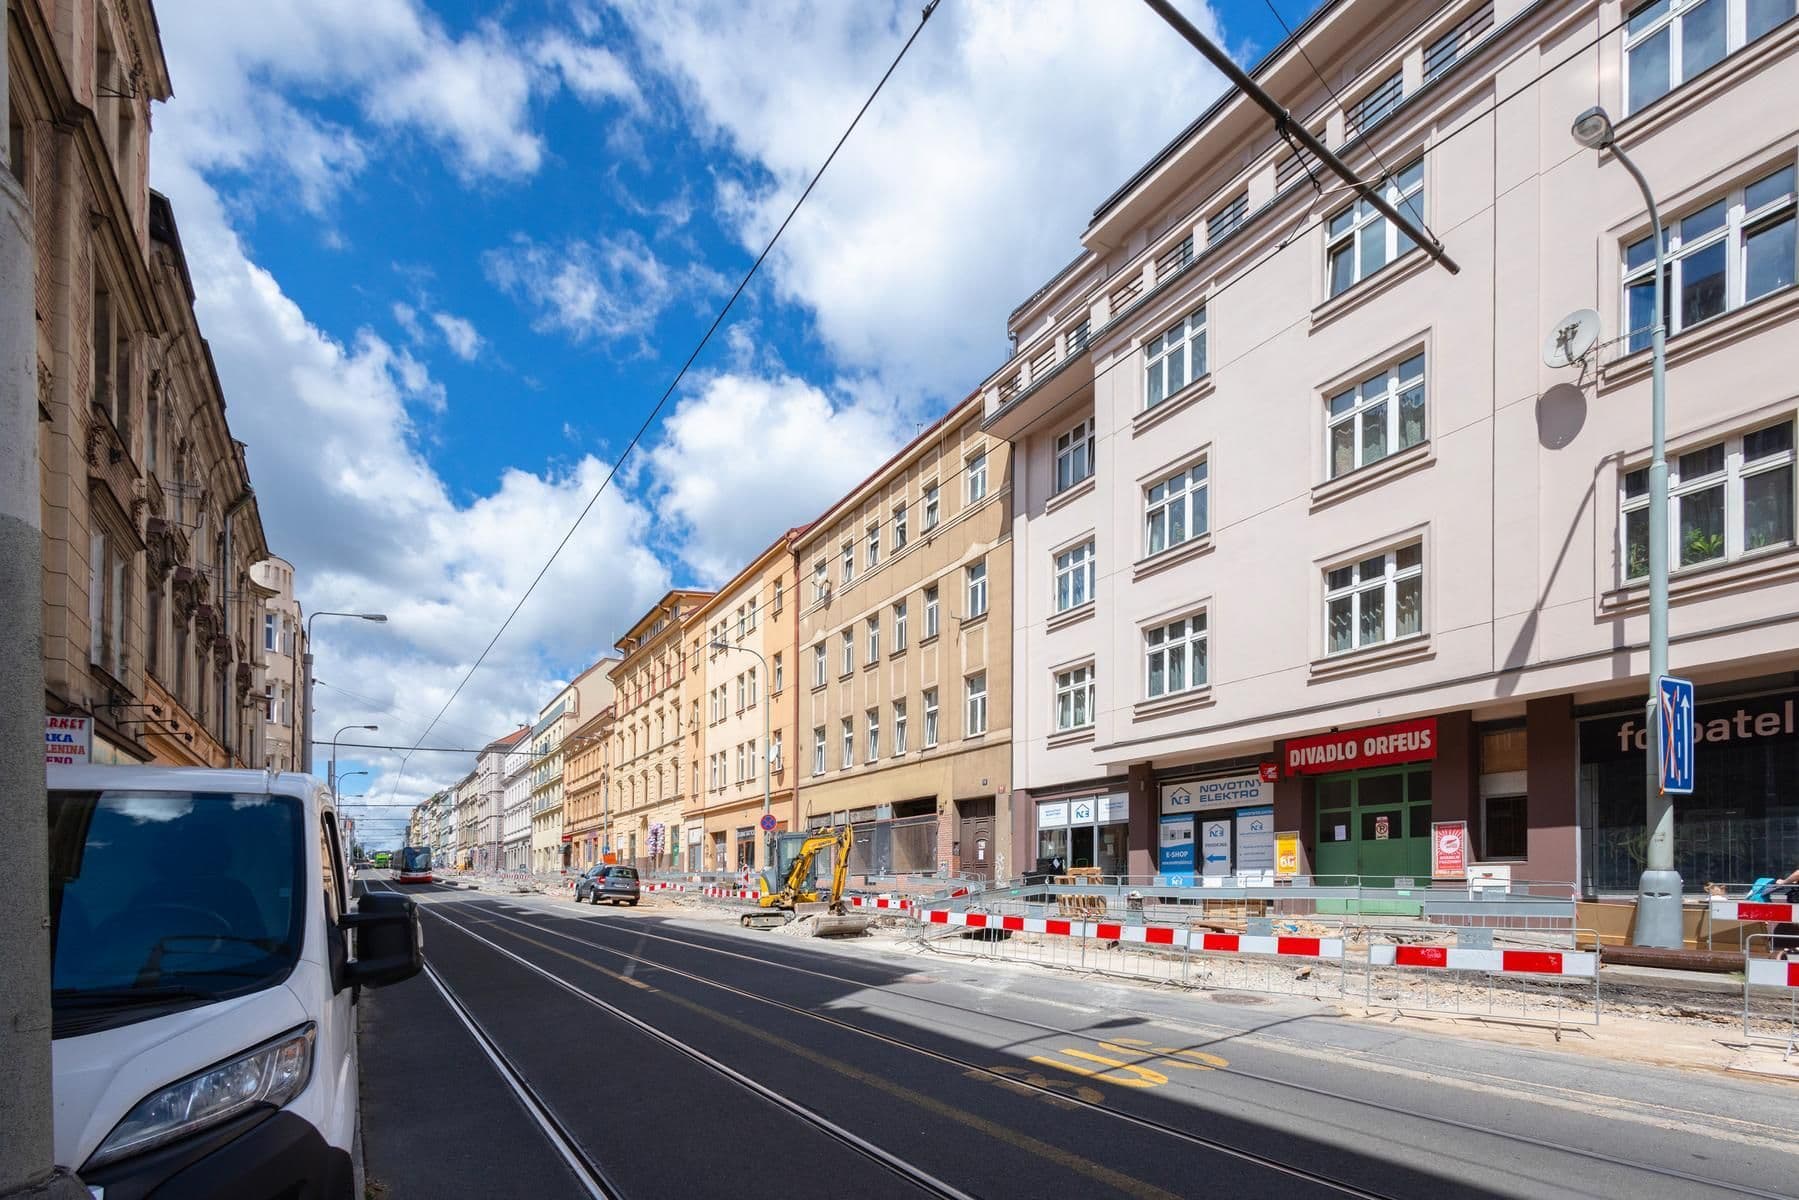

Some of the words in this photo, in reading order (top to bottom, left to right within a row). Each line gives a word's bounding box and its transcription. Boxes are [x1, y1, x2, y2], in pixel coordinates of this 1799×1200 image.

[46, 717, 85, 729] RKET
[46, 744, 86, 755] LENINA
[1289, 741, 1357, 767] DIVADLO
[1364, 729, 1431, 757] ORFEUS
[1200, 789, 1259, 802] ELEKTRO
[1165, 850, 1189, 858] E-SHOP
[962, 1037, 1230, 1111] BUS
